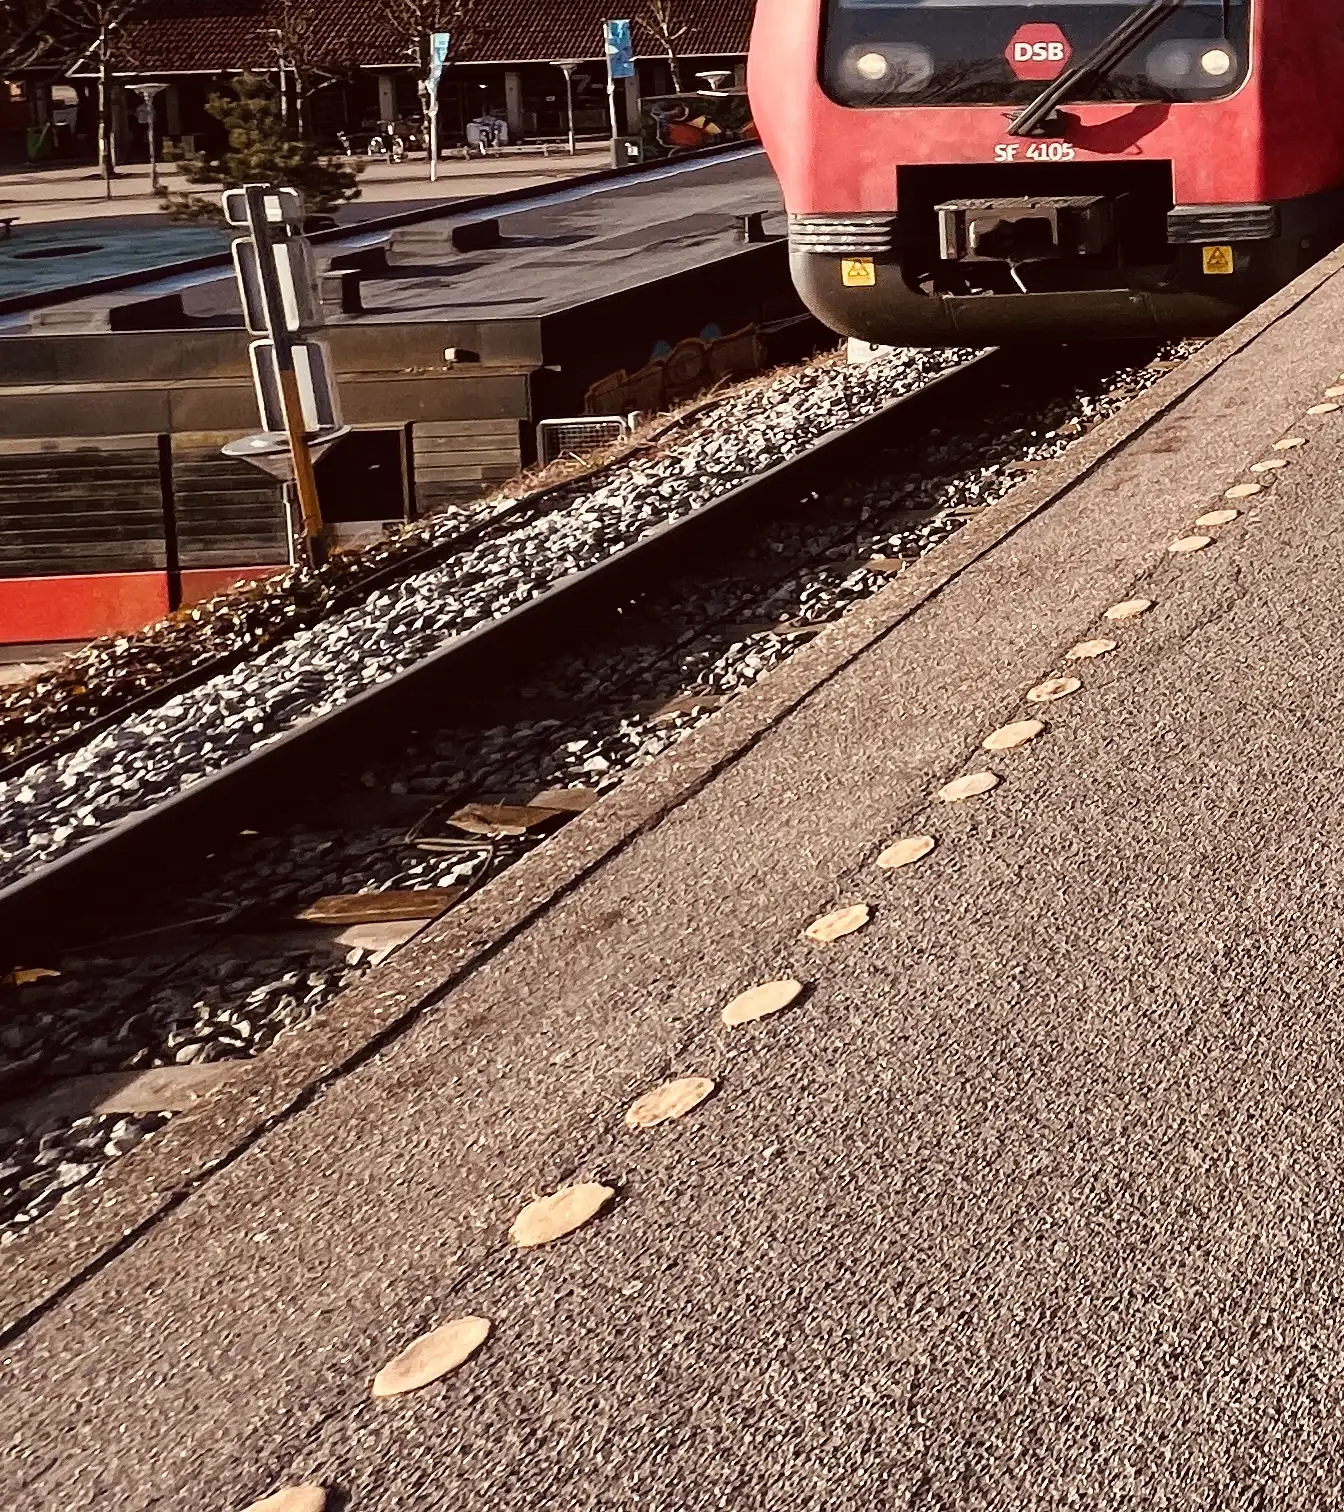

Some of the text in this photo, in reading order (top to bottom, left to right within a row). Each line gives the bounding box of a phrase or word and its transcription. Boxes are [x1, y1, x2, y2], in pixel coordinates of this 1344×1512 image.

[1014, 42, 1064, 61] DSB
[994, 143, 1075, 162] SF 4105
